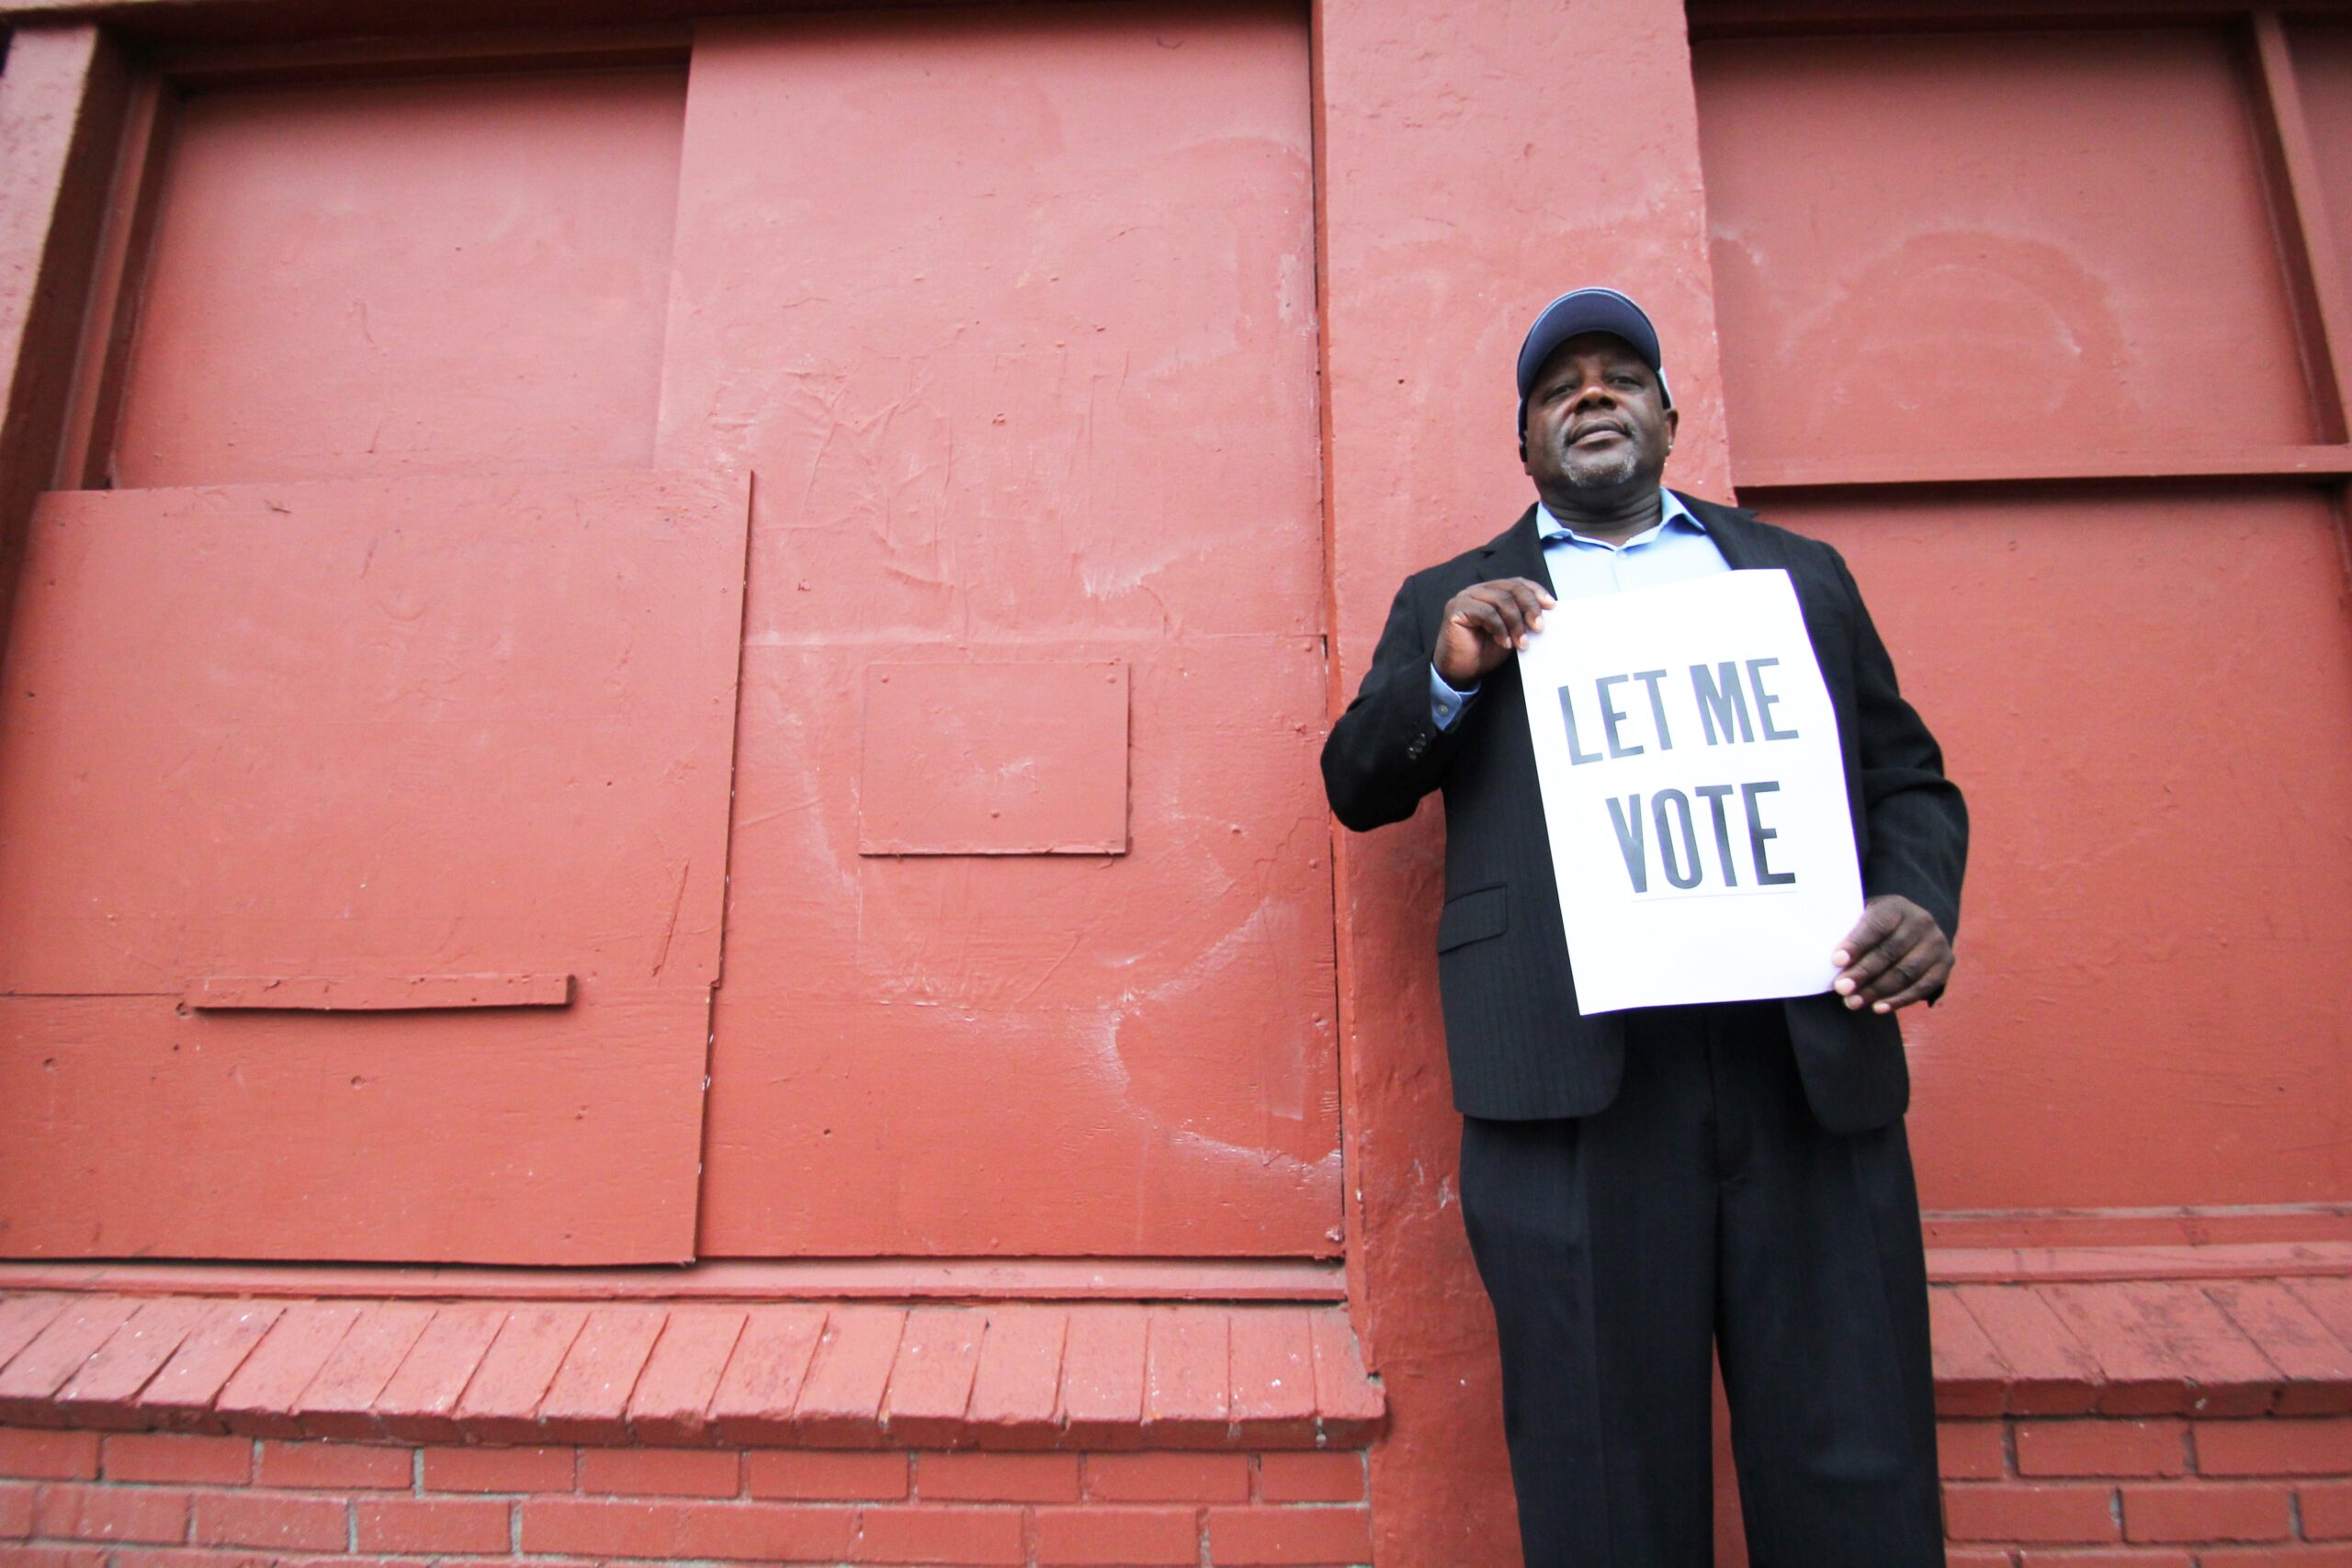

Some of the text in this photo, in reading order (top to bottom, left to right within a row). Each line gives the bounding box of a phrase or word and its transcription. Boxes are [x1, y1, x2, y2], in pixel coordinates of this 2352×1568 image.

[1558, 658, 1799, 765] LET ME
[1605, 781, 1796, 893] VOTE
